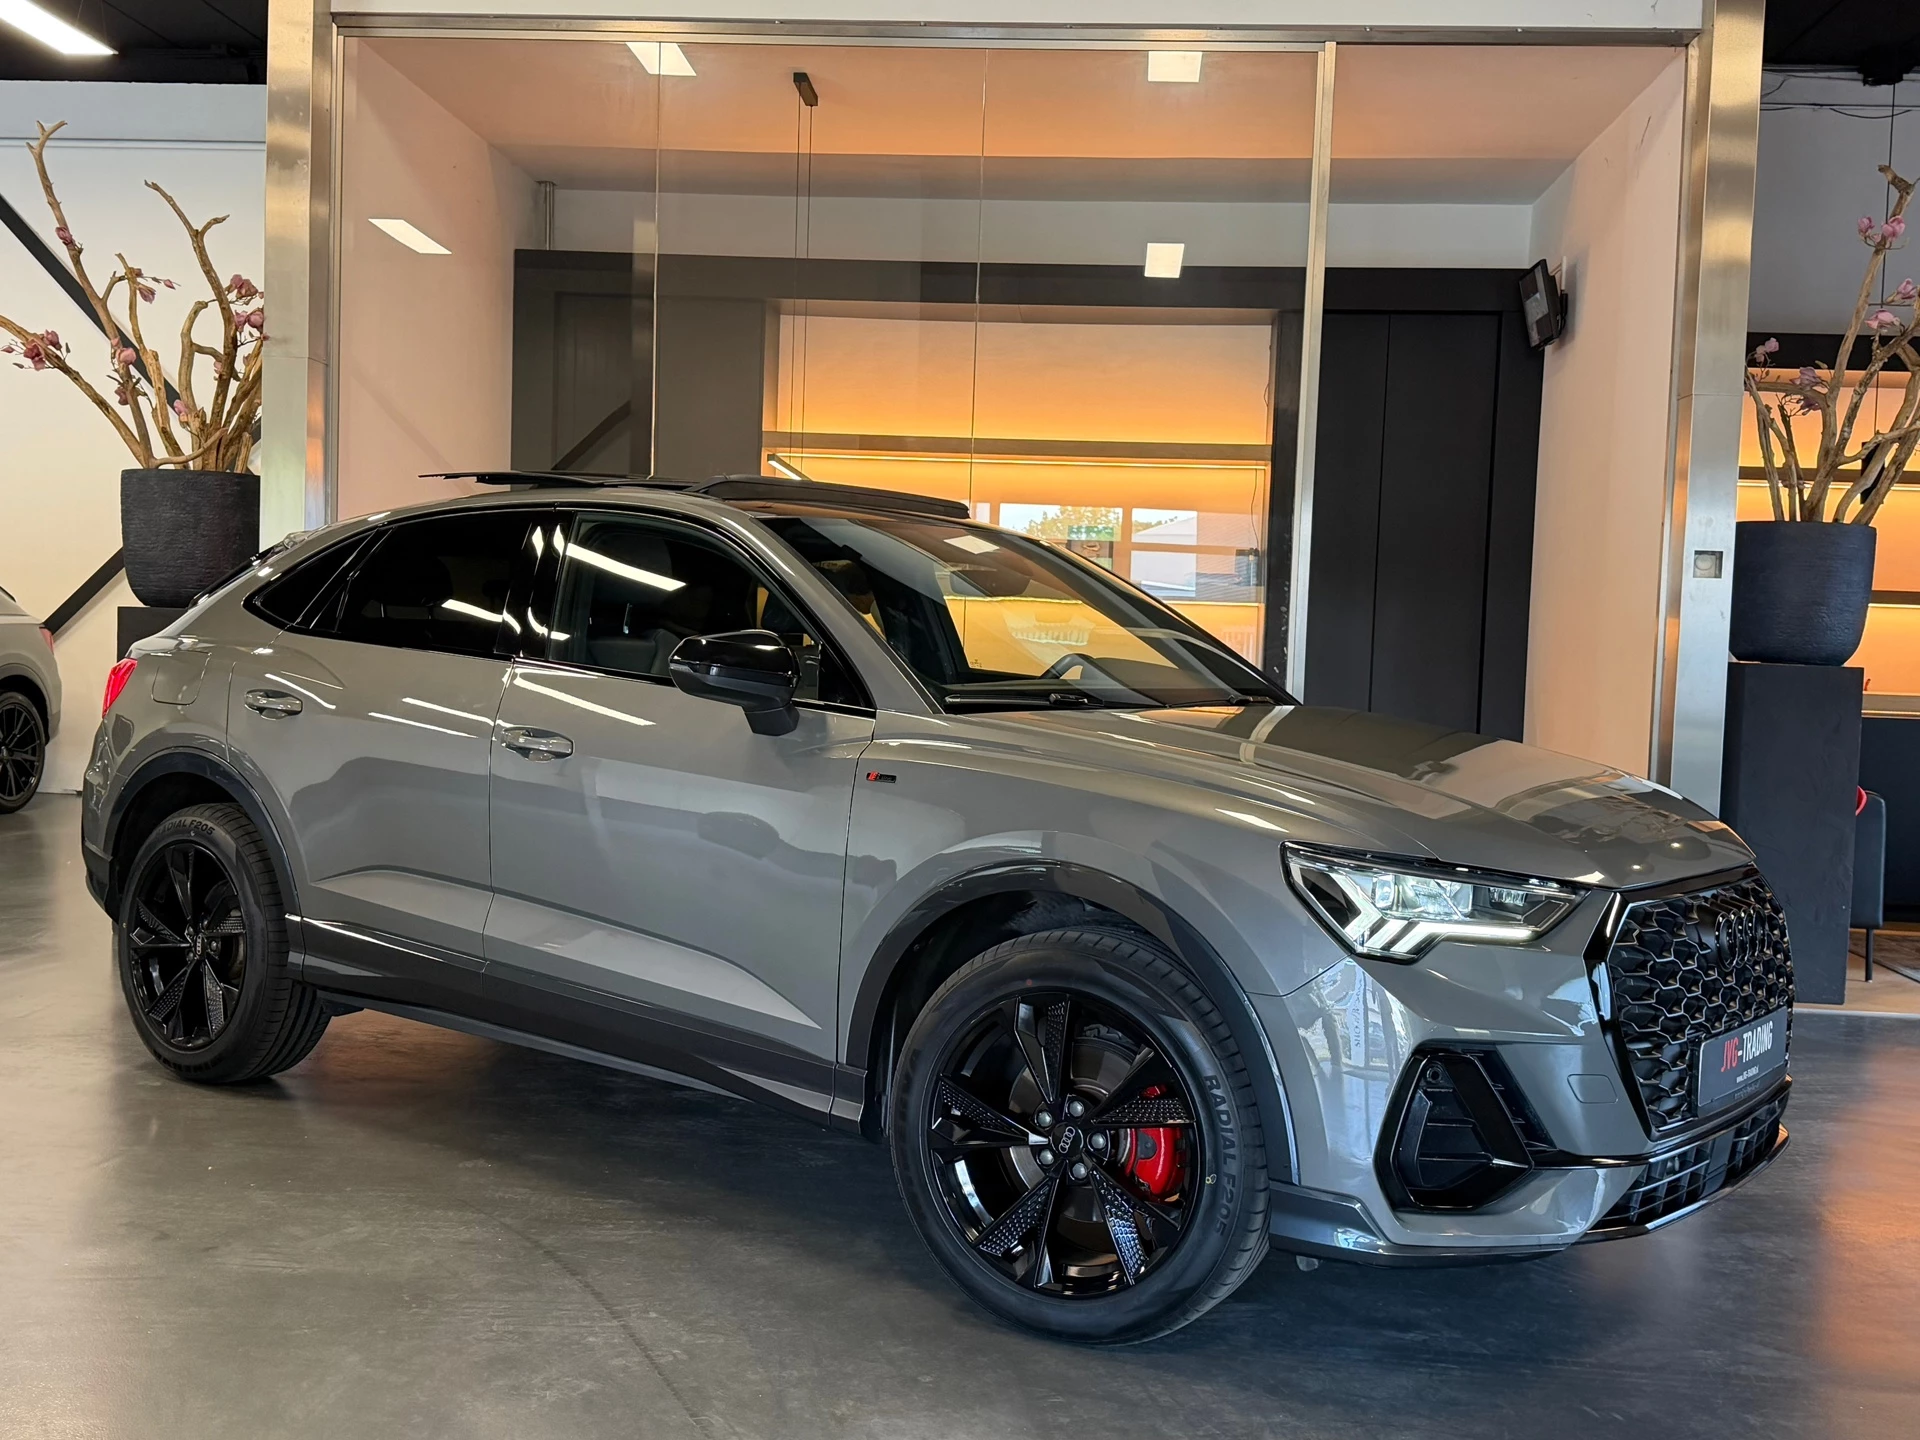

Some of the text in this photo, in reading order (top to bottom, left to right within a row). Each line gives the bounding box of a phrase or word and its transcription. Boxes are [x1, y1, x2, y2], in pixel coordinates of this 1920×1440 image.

[188, 819, 215, 835] F205
[1720, 1020, 1773, 1073] JVG-TRADING
[1204, 1075, 1236, 1236] RADIAL F205
